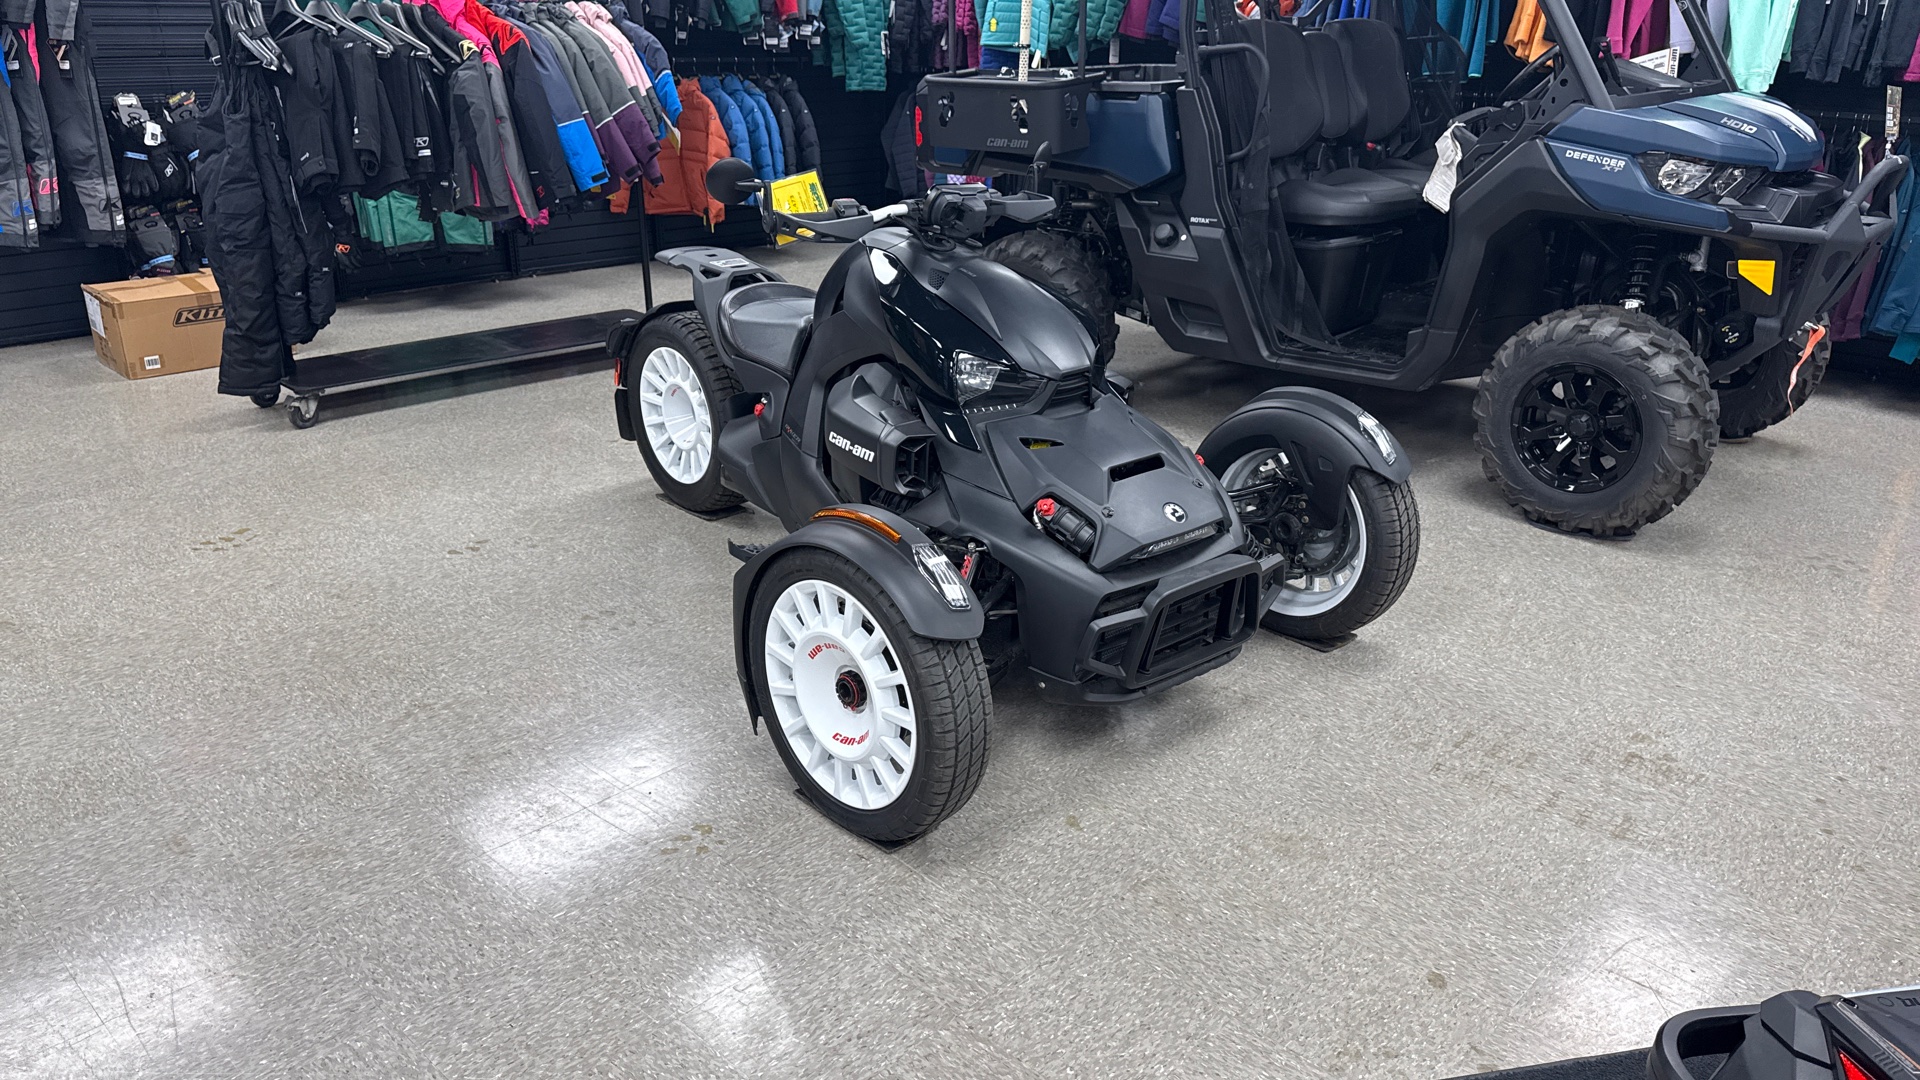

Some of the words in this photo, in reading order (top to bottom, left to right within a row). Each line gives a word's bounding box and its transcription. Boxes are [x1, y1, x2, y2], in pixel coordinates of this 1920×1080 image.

[1670, 49, 1678, 76] an-am
[1720, 116, 1758, 134] HD10
[986, 137, 1029, 149] can-am
[1565, 150, 1625, 168] DEFENDER
[1601, 165, 1623, 173] XT
[1190, 216, 1210, 224] ROTAX
[828, 431, 875, 463] can-am
[831, 729, 870, 746] can-am
